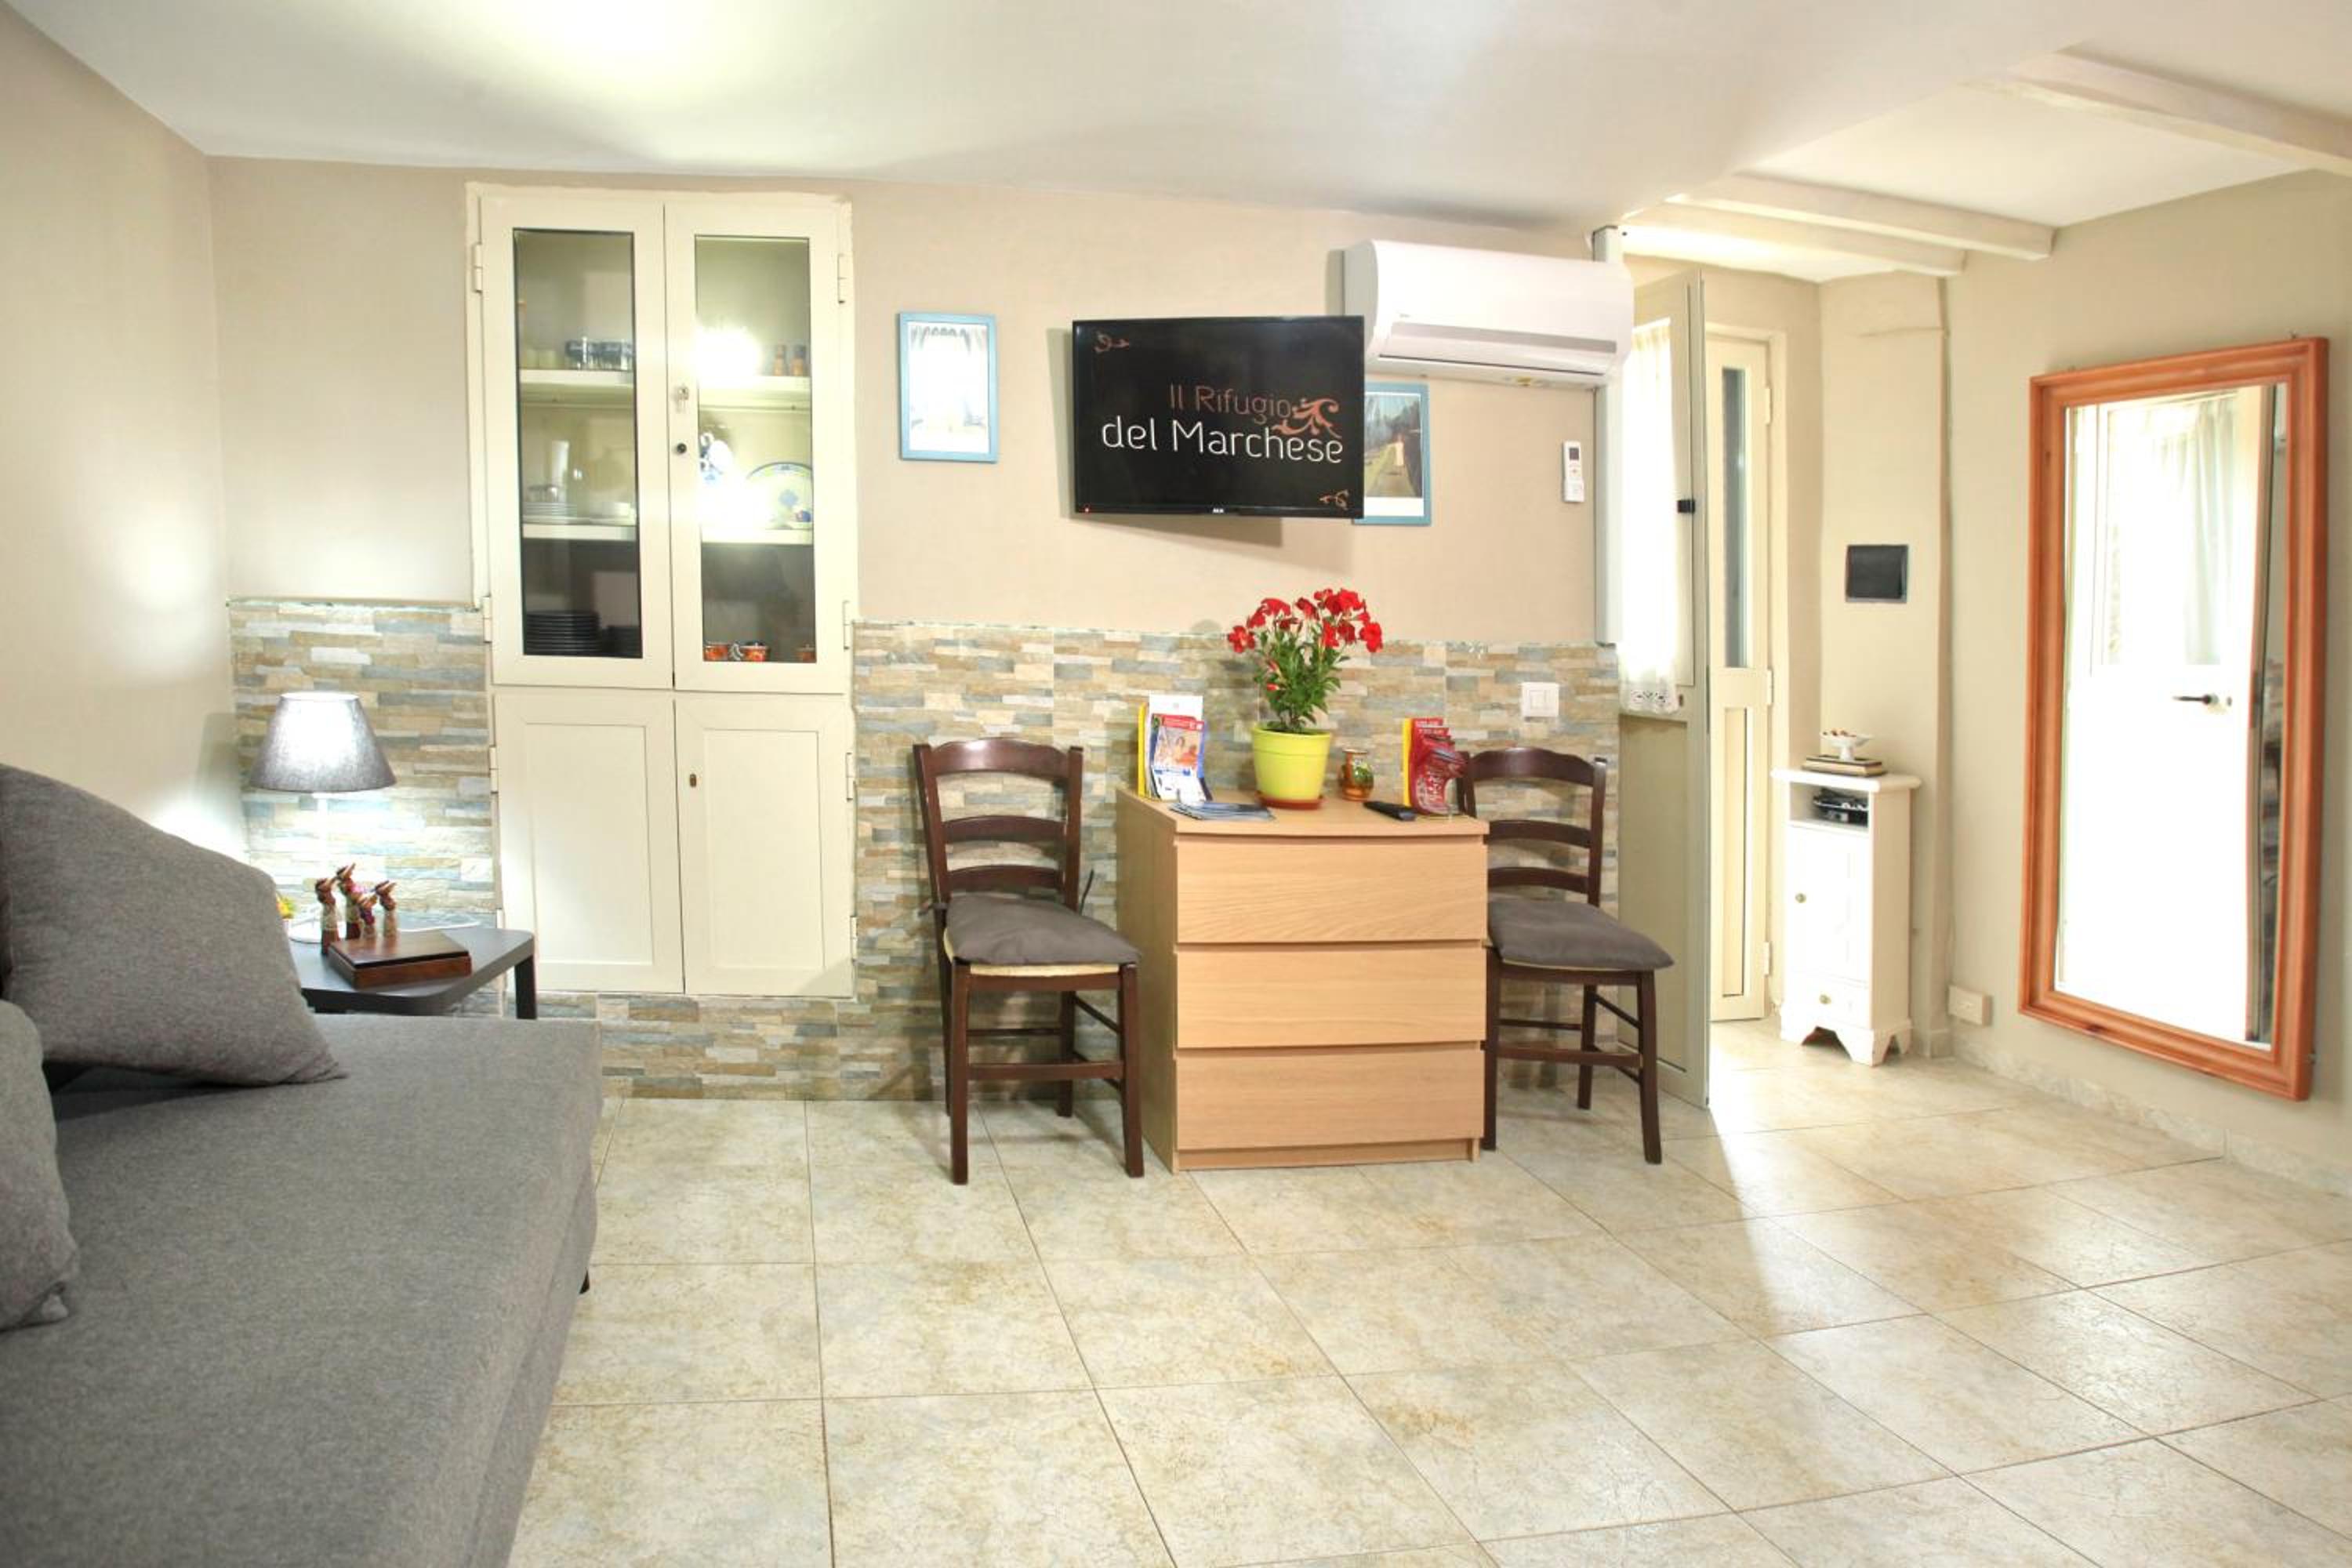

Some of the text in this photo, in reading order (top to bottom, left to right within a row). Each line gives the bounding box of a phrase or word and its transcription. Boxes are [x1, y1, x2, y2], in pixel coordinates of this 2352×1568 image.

[1170, 383, 1291, 425] Il Rifugio
[1102, 415, 1343, 463] del Marchese
